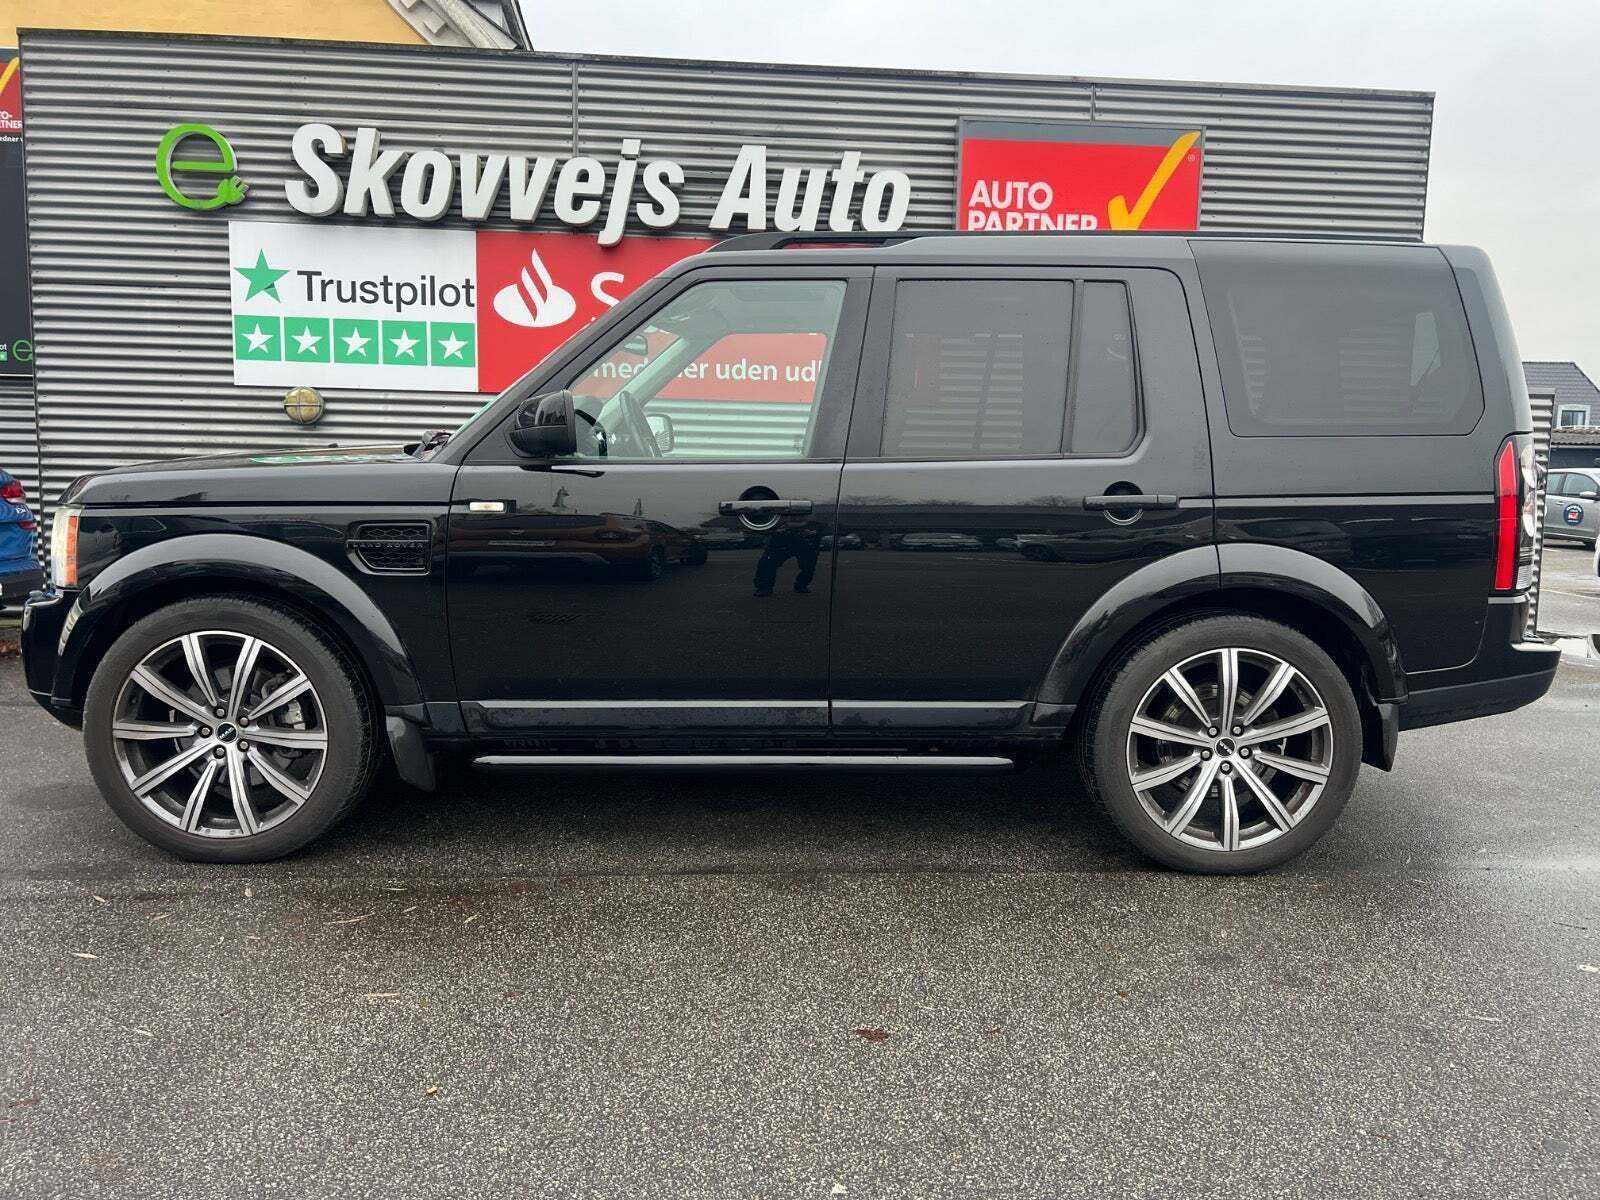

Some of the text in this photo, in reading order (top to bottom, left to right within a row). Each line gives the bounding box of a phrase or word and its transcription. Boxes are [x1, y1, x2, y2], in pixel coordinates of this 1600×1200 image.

[285, 123, 685, 247] Skovvejs
[708, 144, 912, 232] Auto
[968, 179, 1053, 211] AUTO
[967, 210, 1098, 231] PARTNER
[296, 270, 475, 313] Trustpilot
[715, 358, 778, 380] uden
